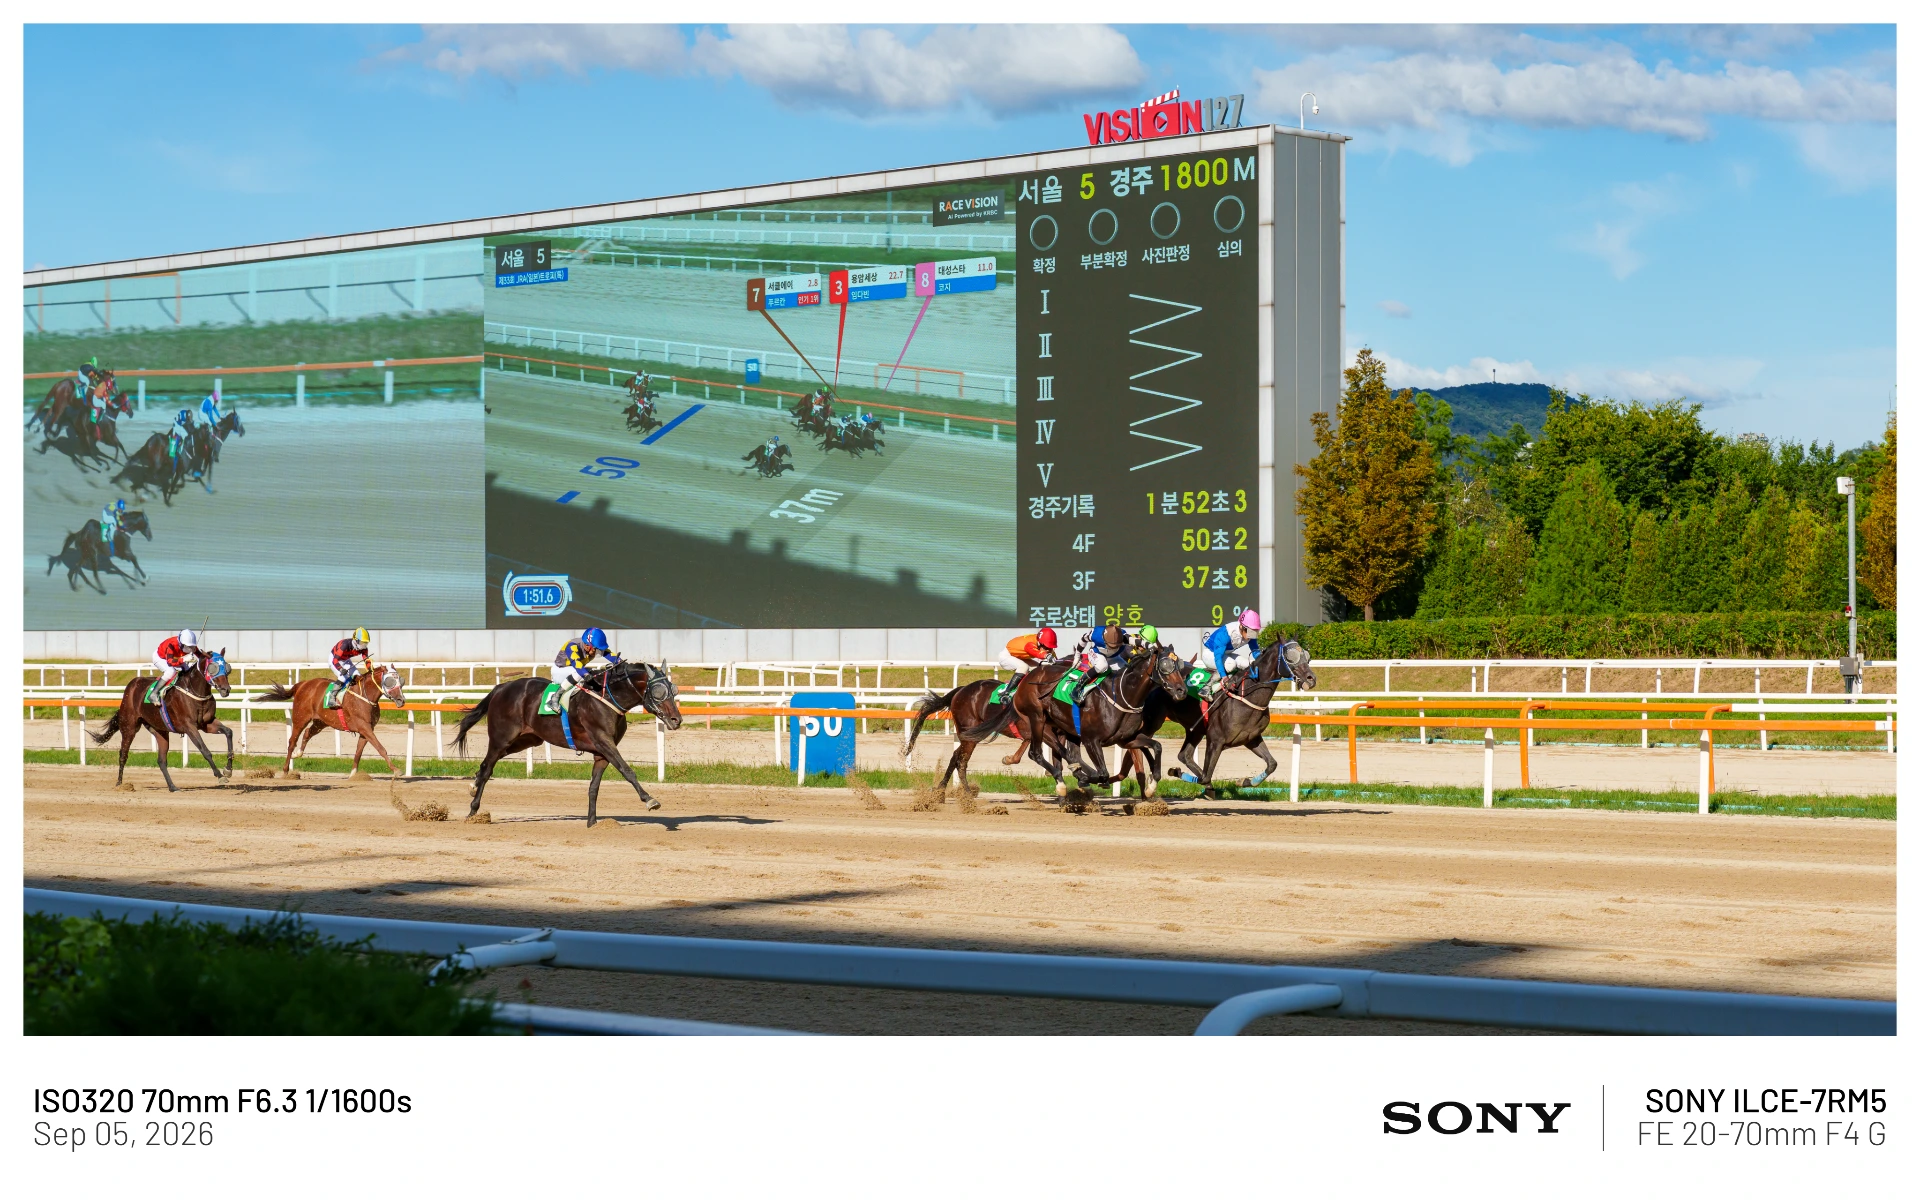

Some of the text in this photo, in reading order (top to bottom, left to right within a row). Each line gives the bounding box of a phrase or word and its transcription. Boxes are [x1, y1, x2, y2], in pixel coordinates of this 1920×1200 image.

[1083, 89, 1244, 145] VISION 127
[1018, 176, 1063, 204] 서울
[1079, 173, 1095, 199] 5
[1109, 166, 1153, 197] 경주
[939, 196, 998, 212] RACE VISION
[501, 247, 545, 268] 서울 5
[1141, 244, 1190, 264] 사진판정
[1217, 239, 1242, 258] 심의
[938, 262, 993, 276] 대성스타 11.0
[1032, 257, 1056, 274] 확정
[1080, 250, 1128, 270] 부분확정
[767, 278, 819, 291] 서클에이 2.8
[851, 270, 904, 284] 용암세상 22.7
[921, 272, 930, 288] 8
[752, 287, 760, 302] 7
[835, 280, 843, 296] 3
[938, 282, 951, 292] 코지
[798, 295, 809, 305] 인기
[1040, 290, 1051, 314] I
[579, 456, 641, 480] 50
[1037, 463, 1054, 488] V
[769, 488, 844, 524] 37m
[1029, 494, 1095, 519] 경주기록
[1072, 534, 1095, 553] 4F
[1072, 571, 1095, 591] 3F
[523, 588, 554, 604] 1:51.6
[1029, 605, 1095, 628] 주로상태
[1103, 603, 1145, 627] 양호
[1211, 604, 1224, 626] 9
[1186, 672, 1205, 687] 8
